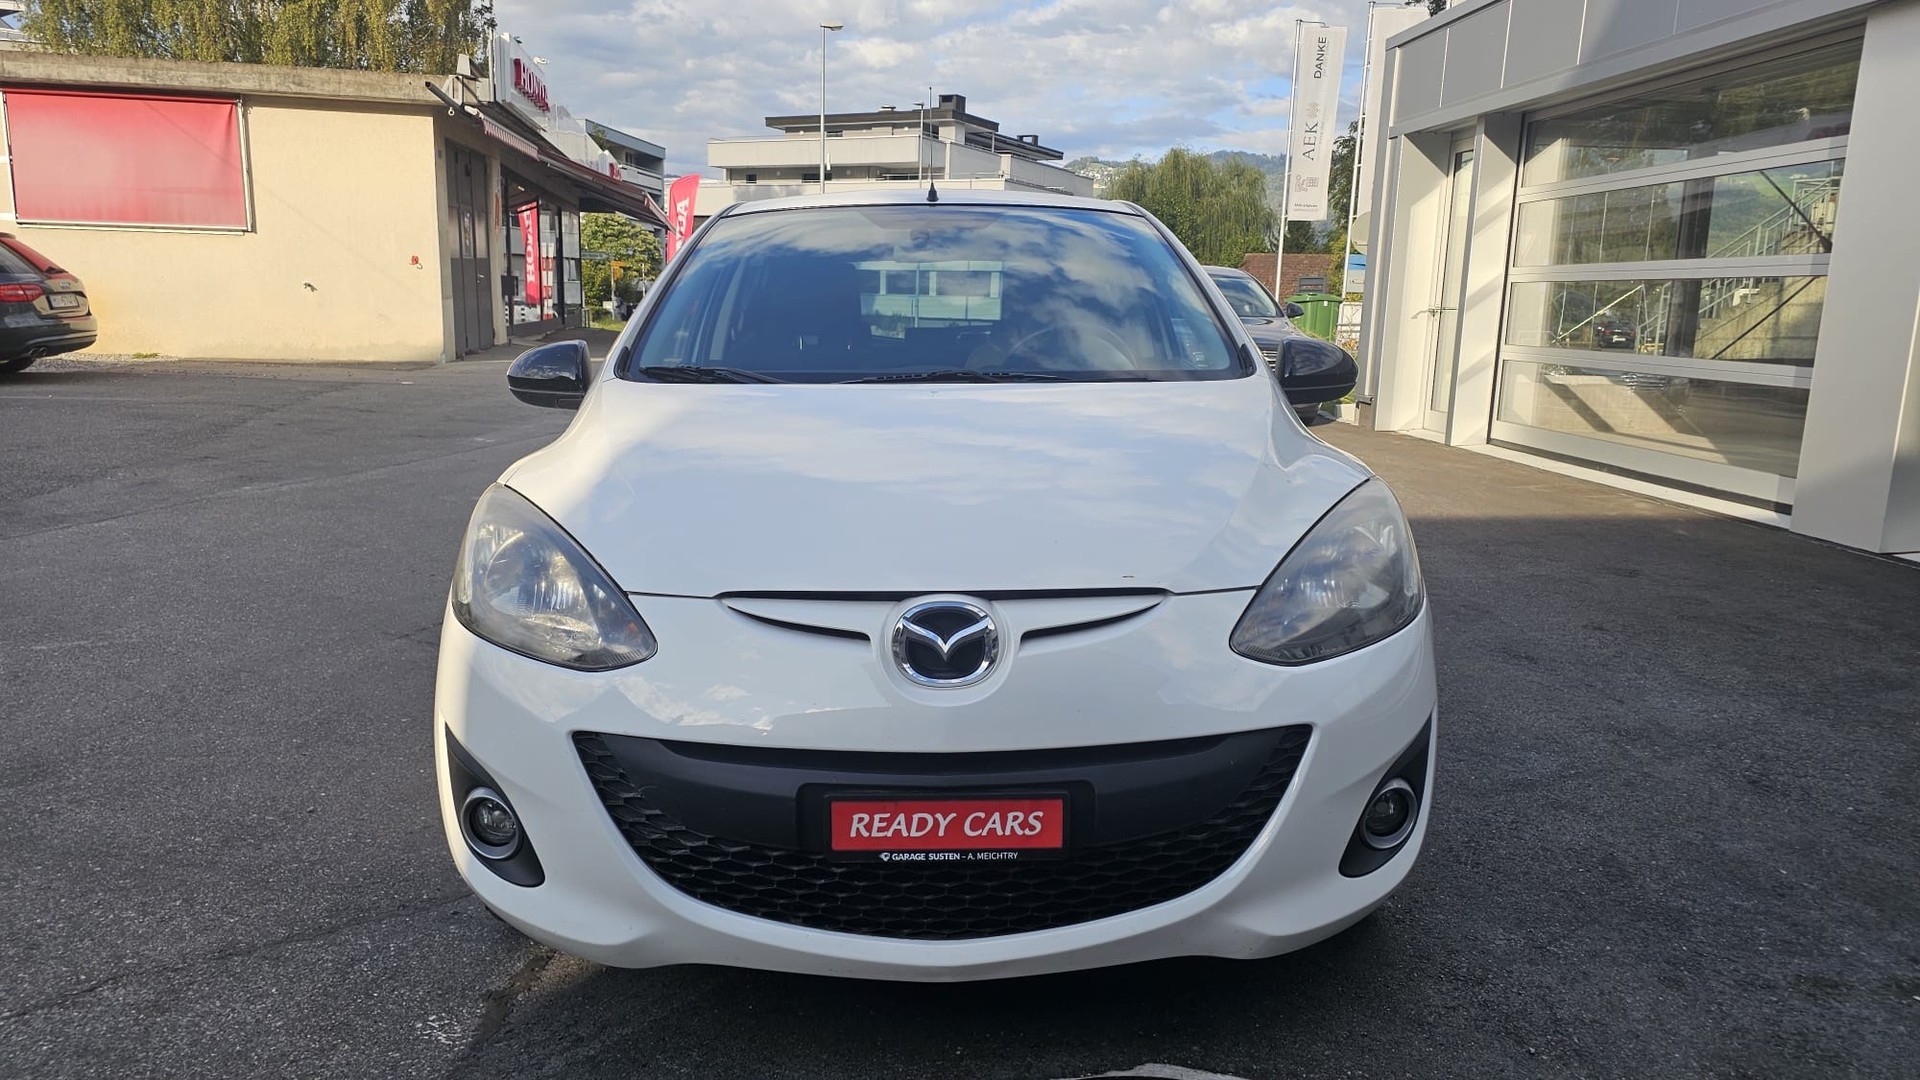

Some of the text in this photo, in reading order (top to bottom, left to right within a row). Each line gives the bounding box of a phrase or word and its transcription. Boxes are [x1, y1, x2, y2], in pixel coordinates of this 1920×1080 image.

[1313, 36, 1327, 79] DANKE
[1302, 121, 1319, 161] AEK
[850, 811, 1044, 838] READY CARS
[891, 853, 926, 861] GARAGE
[928, 852, 960, 861] SUSTEN
[976, 851, 1019, 860] MEICHTRY
